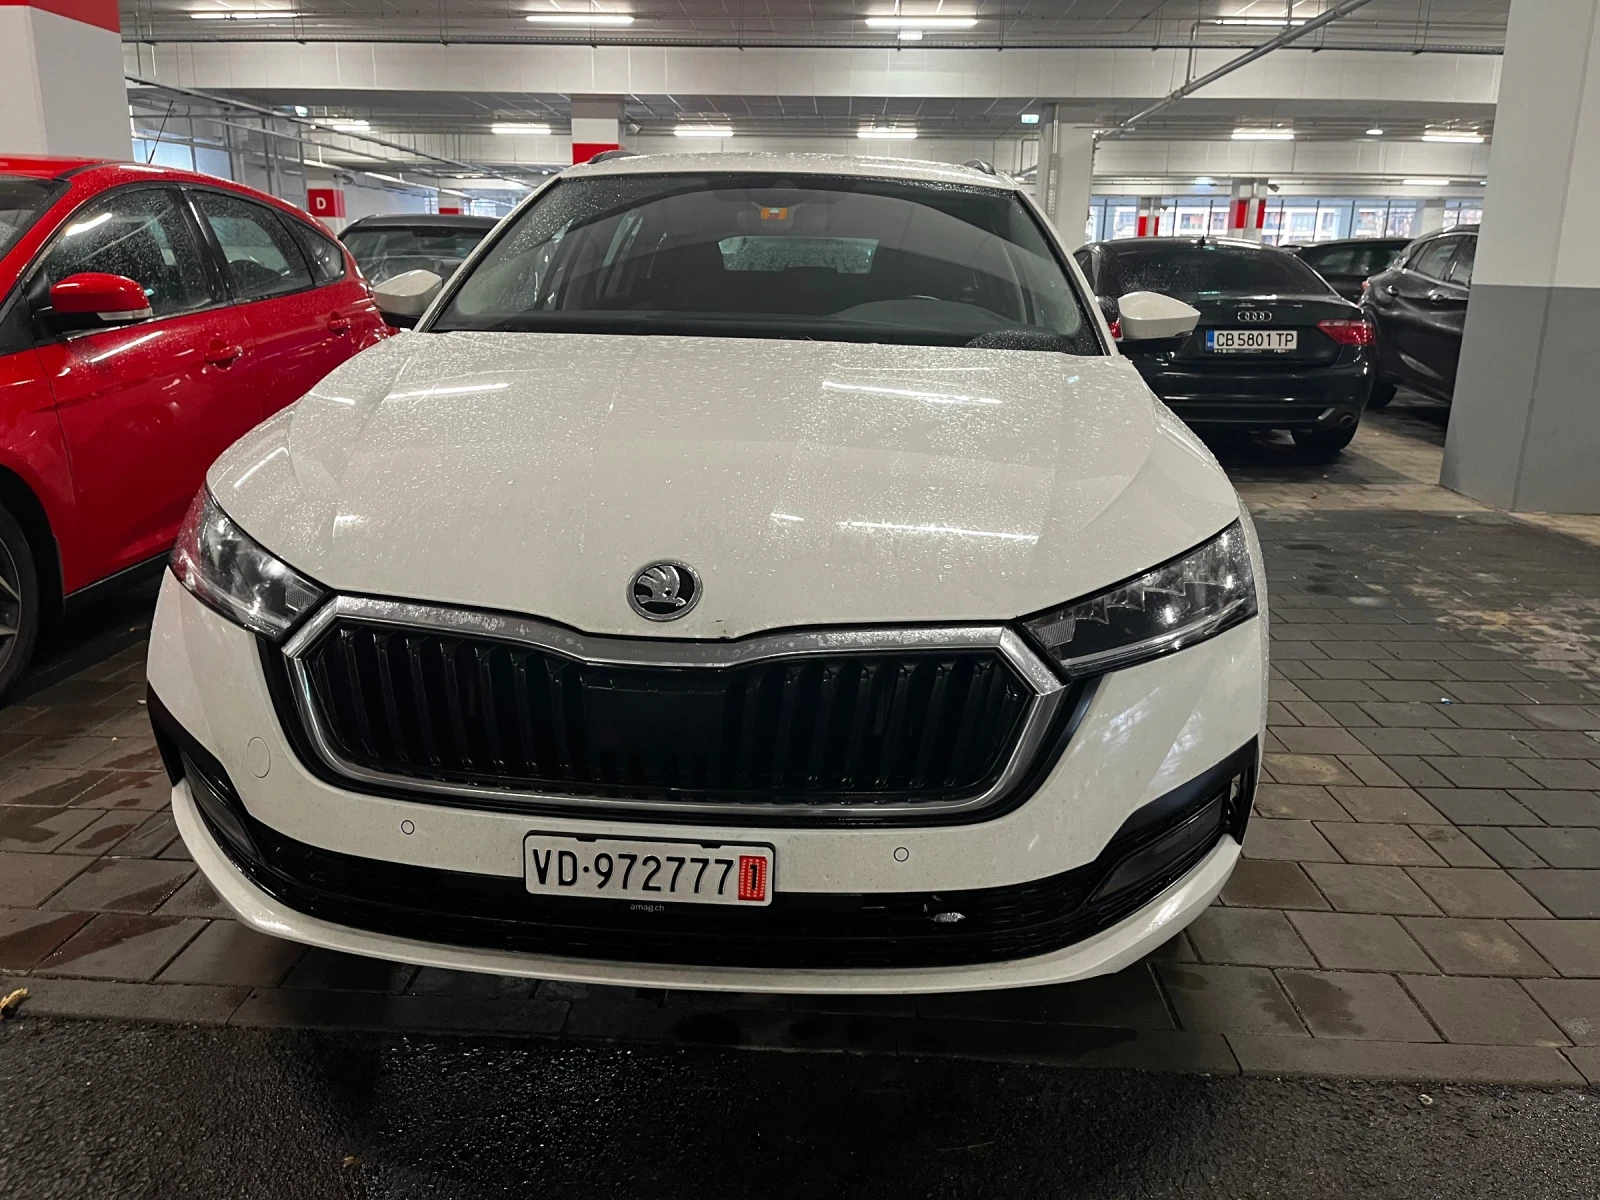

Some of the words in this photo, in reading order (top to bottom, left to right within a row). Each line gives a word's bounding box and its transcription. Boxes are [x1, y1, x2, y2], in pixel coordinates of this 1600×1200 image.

[316, 197, 327, 210] D
[1216, 333, 1235, 347] CB
[1237, 333, 1272, 347] 5801
[1276, 333, 1294, 347] TP
[630, 903, 665, 912] amag.ch
